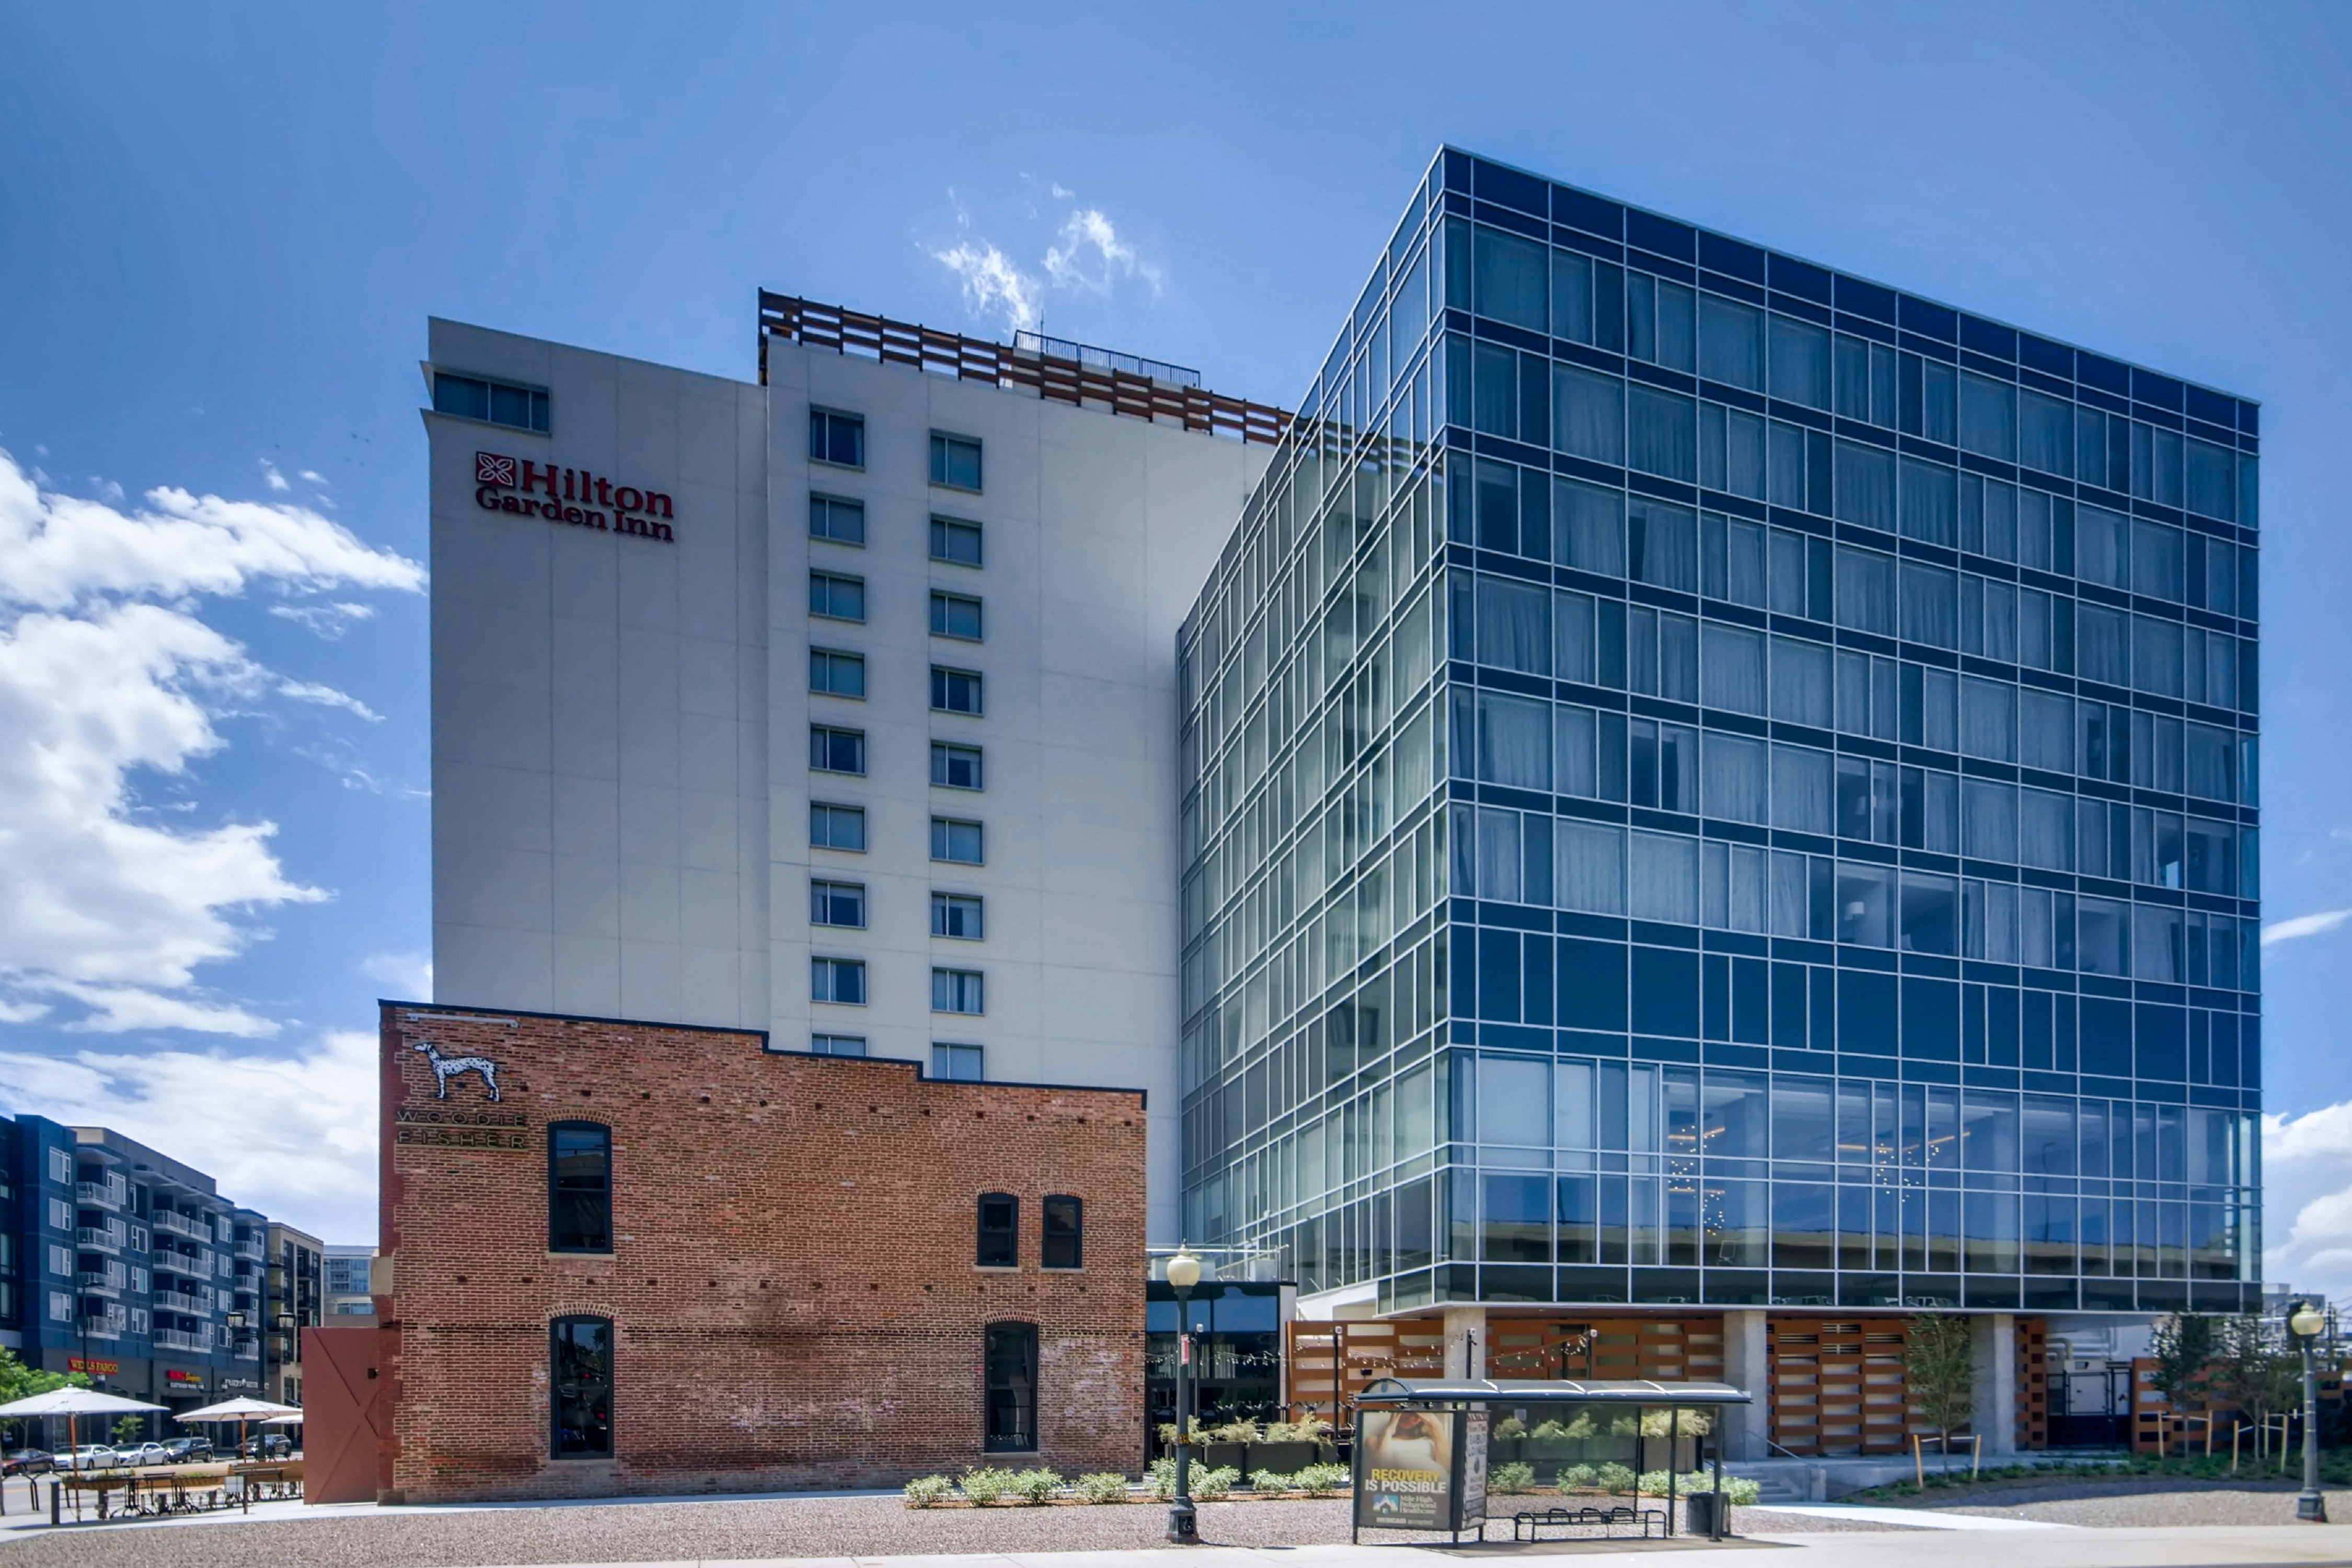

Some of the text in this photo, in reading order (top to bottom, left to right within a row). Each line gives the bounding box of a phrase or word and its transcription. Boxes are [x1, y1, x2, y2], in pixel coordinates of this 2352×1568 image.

[521, 459, 673, 518] Hilton
[476, 486, 674, 543] Garden Inn
[397, 1111, 524, 1126] WOODIE
[398, 1131, 525, 1148] FISHER
[96, 1362, 118, 1373] FARGO
[1371, 1468, 1440, 1482] RECOVERY
[1365, 1479, 1447, 1494] IS POSSIBLE
